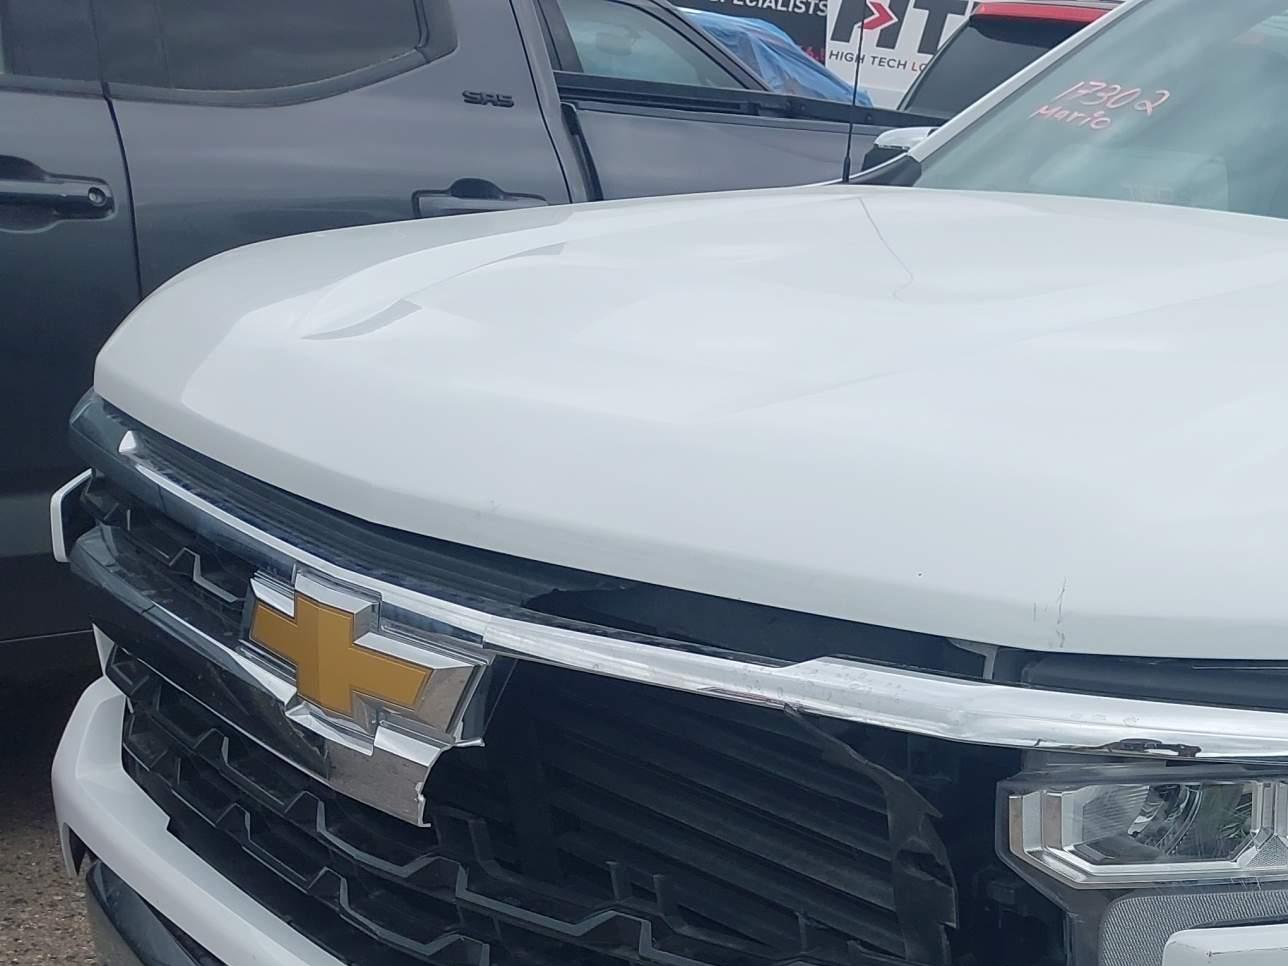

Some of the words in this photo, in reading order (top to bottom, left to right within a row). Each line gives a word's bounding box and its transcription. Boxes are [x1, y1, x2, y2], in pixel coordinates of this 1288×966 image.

[709, 0, 828, 16] IALISTS
[828, 50, 865, 64] HIGH
[870, 55, 907, 70] TECH
